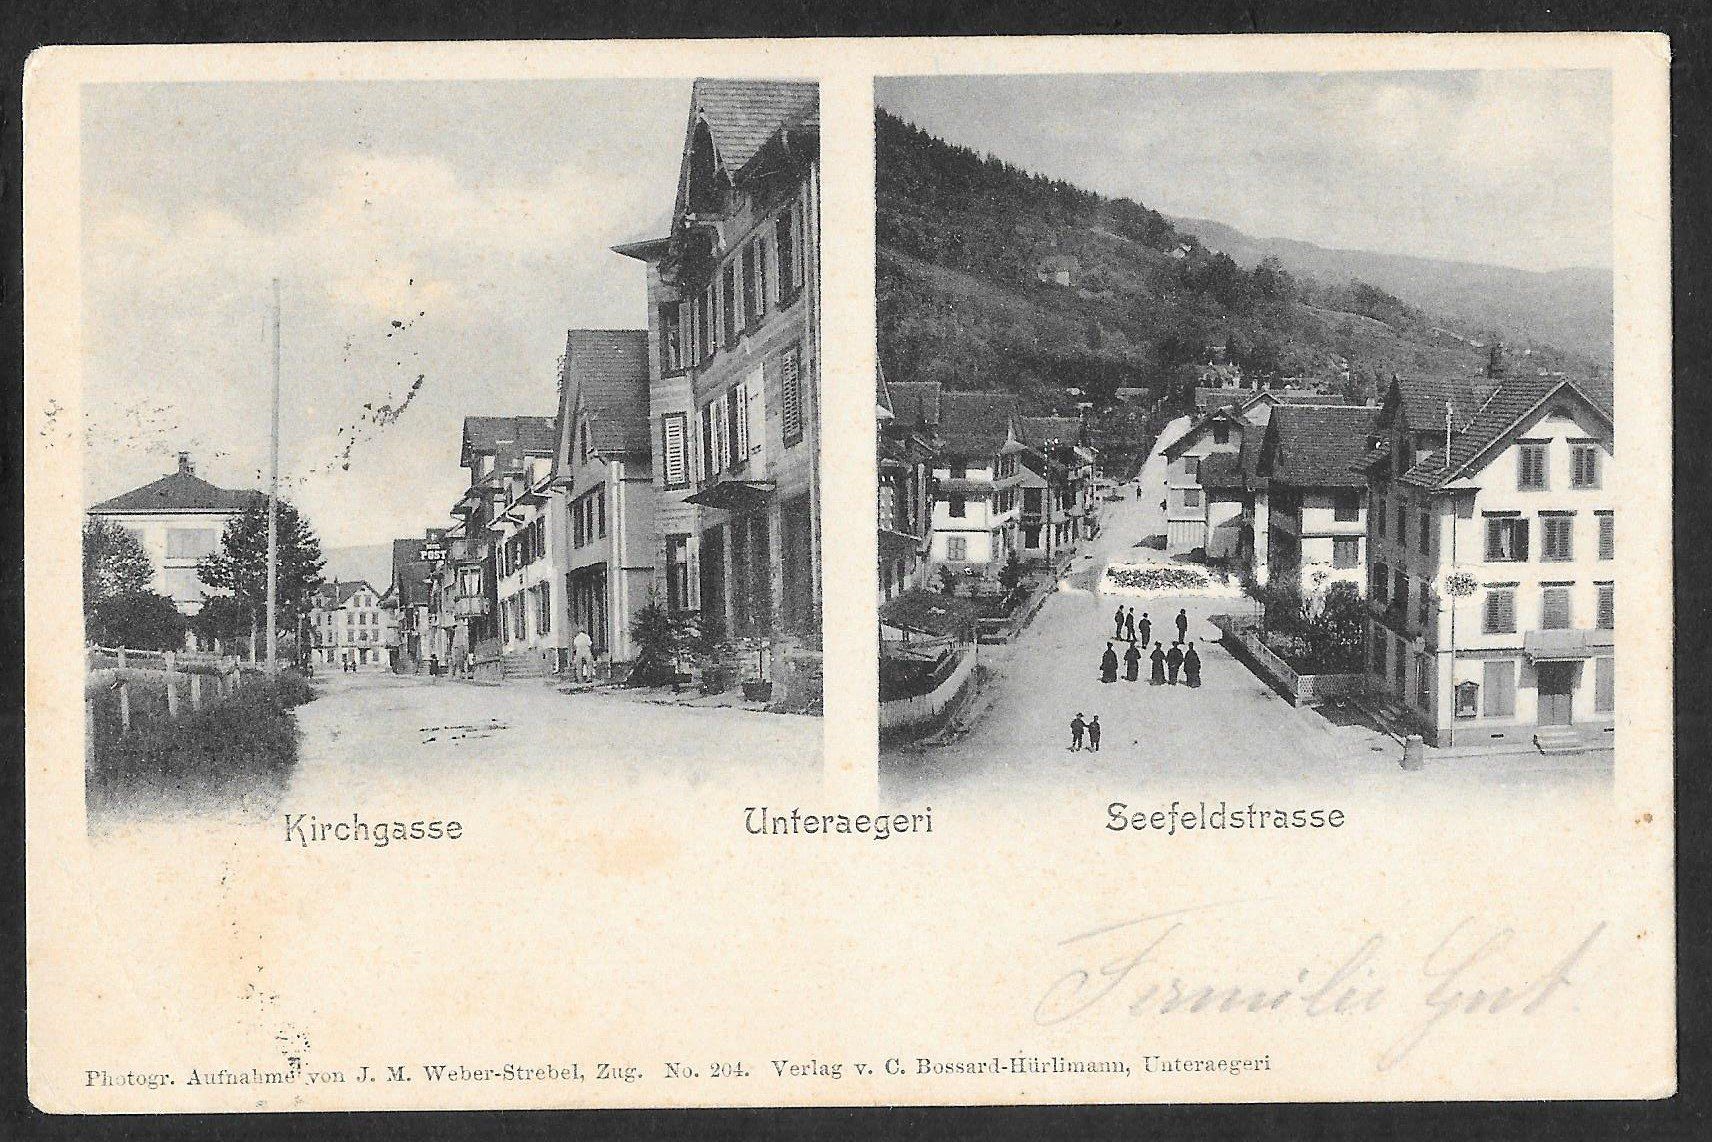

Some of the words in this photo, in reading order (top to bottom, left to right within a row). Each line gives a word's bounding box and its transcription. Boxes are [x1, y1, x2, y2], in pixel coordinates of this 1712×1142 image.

[420, 550, 447, 560] POST
[285, 811, 463, 848] Kirchgasse
[744, 806, 934, 841] Unteraegeri
[1105, 802, 1345, 836] Seefeldstrasse
[85, 1069, 176, 1091] Photogr.
[187, 1067, 294, 1087] Aufnahme
[308, 1072, 346, 1085] von
[357, 1066, 376, 1083] J.
[387, 1065, 412, 1082] M.
[423, 1063, 586, 1083] Weber-Strebel,
[597, 1063, 643, 1083] Zug.
[664, 1062, 699, 1079] No.
[710, 1061, 751, 1078] 204.
[771, 1059, 843, 1079] Verlag
[854, 1063, 873, 1076] v.
[885, 1058, 906, 1075] C.
[916, 1056, 1132, 1077] Bossard-Hürlimann,
[1143, 1054, 1272, 1077] Unteraegeri
